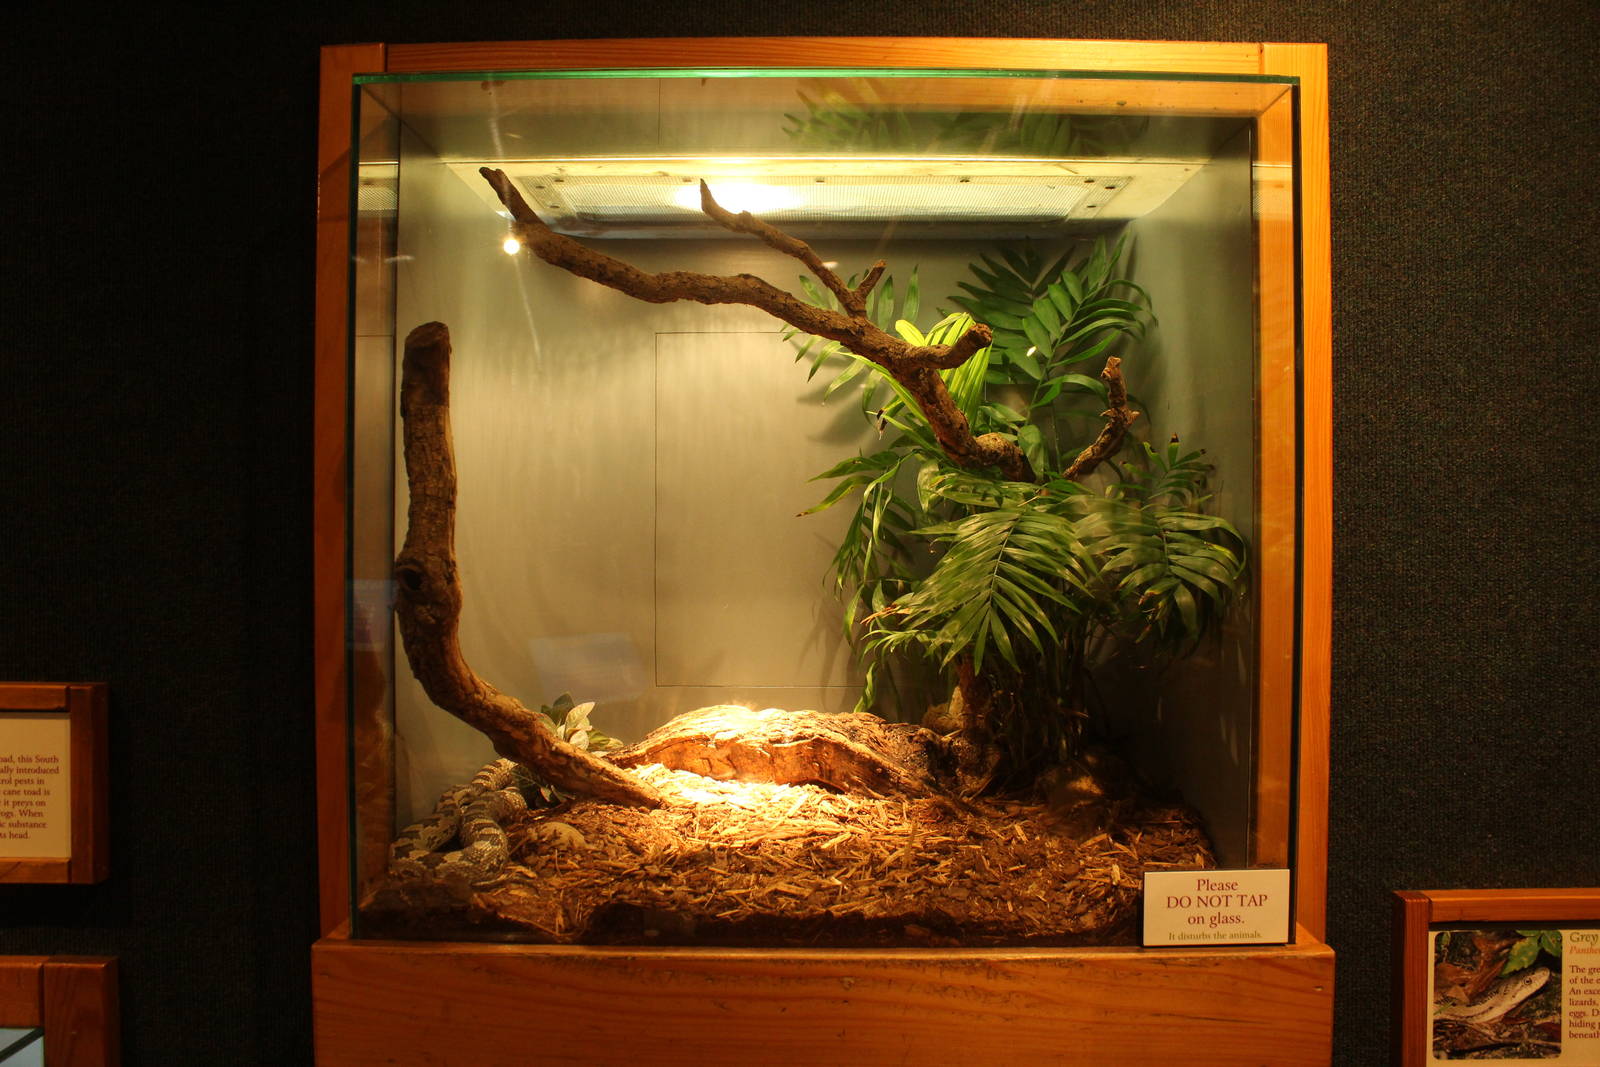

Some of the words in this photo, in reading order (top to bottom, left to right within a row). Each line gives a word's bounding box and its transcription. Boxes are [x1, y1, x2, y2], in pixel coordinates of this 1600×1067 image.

[18, 755, 32, 763] this
[35, 755, 59, 763] South
[16, 766, 59, 774] introduced
[14, 778, 34, 787] pests
[24, 788, 41, 796] toad
[44, 788, 50, 796] is
[4, 799, 9, 807] it
[12, 800, 33, 809] preys
[19, 809, 44, 817] When
[9, 820, 47, 828] substance
[10, 831, 30, 839] head.
[1197, 878, 1238, 891] Please
[1167, 896, 1192, 908] DO
[1197, 894, 1232, 908] NOT
[1237, 894, 1268, 908] TAP
[1188, 914, 1204, 925] on
[1209, 912, 1244, 928] glass.
[1168, 932, 1175, 940] It
[1178, 932, 1211, 940] disturbs
[1213, 931, 1226, 940] the
[1229, 930, 1262, 940] animals.
[1570, 932, 1598, 945] Grey
[1569, 965, 1586, 974] The
[1570, 976, 1578, 984] of
[1580, 976, 1594, 984] the
[1569, 987, 1581, 995] An
[1569, 1020, 1596, 1030] hiding
